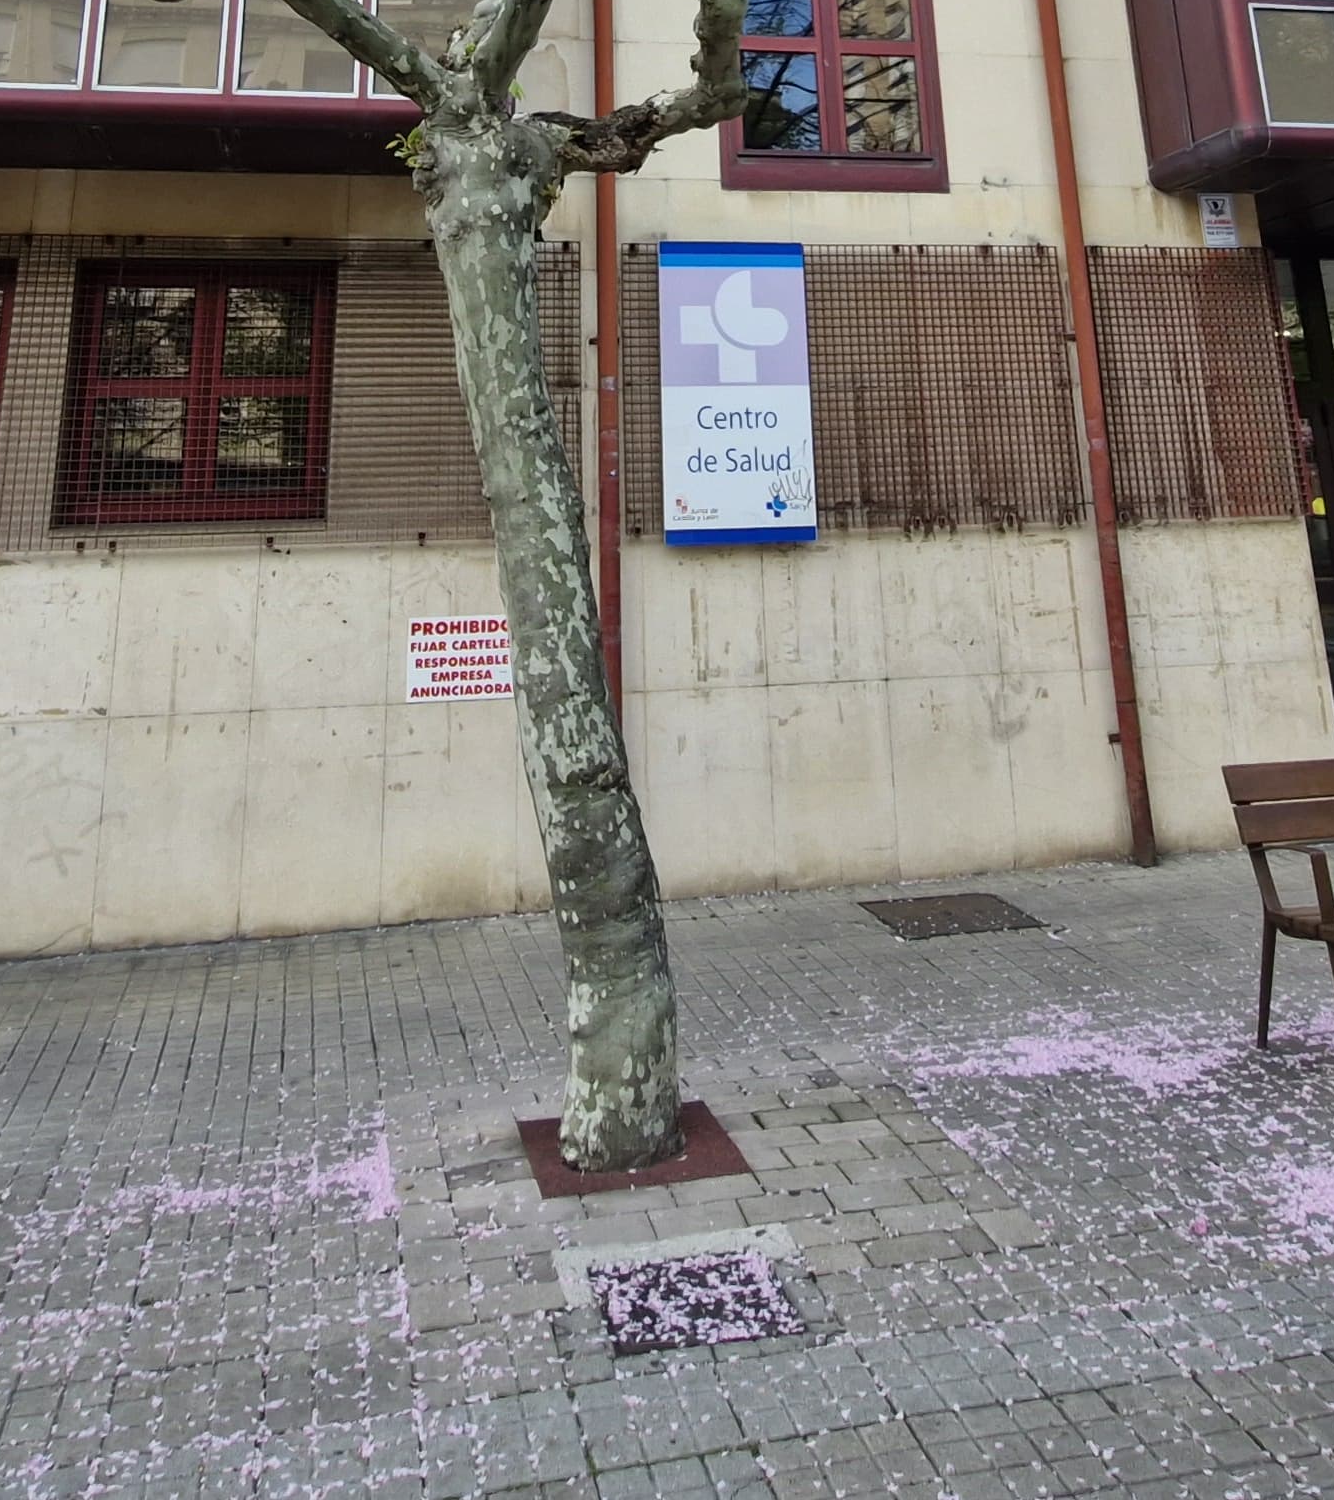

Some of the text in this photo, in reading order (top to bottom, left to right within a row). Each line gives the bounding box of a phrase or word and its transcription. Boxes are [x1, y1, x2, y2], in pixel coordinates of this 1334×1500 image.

[697, 405, 778, 430] Centro
[687, 445, 791, 473] de Salud
[410, 641, 447, 653] FIJAR
[415, 654, 509, 669] RESPONSABLE
[431, 670, 493, 682] EMPRESA
[410, 683, 512, 698] ANUNCIADORA
